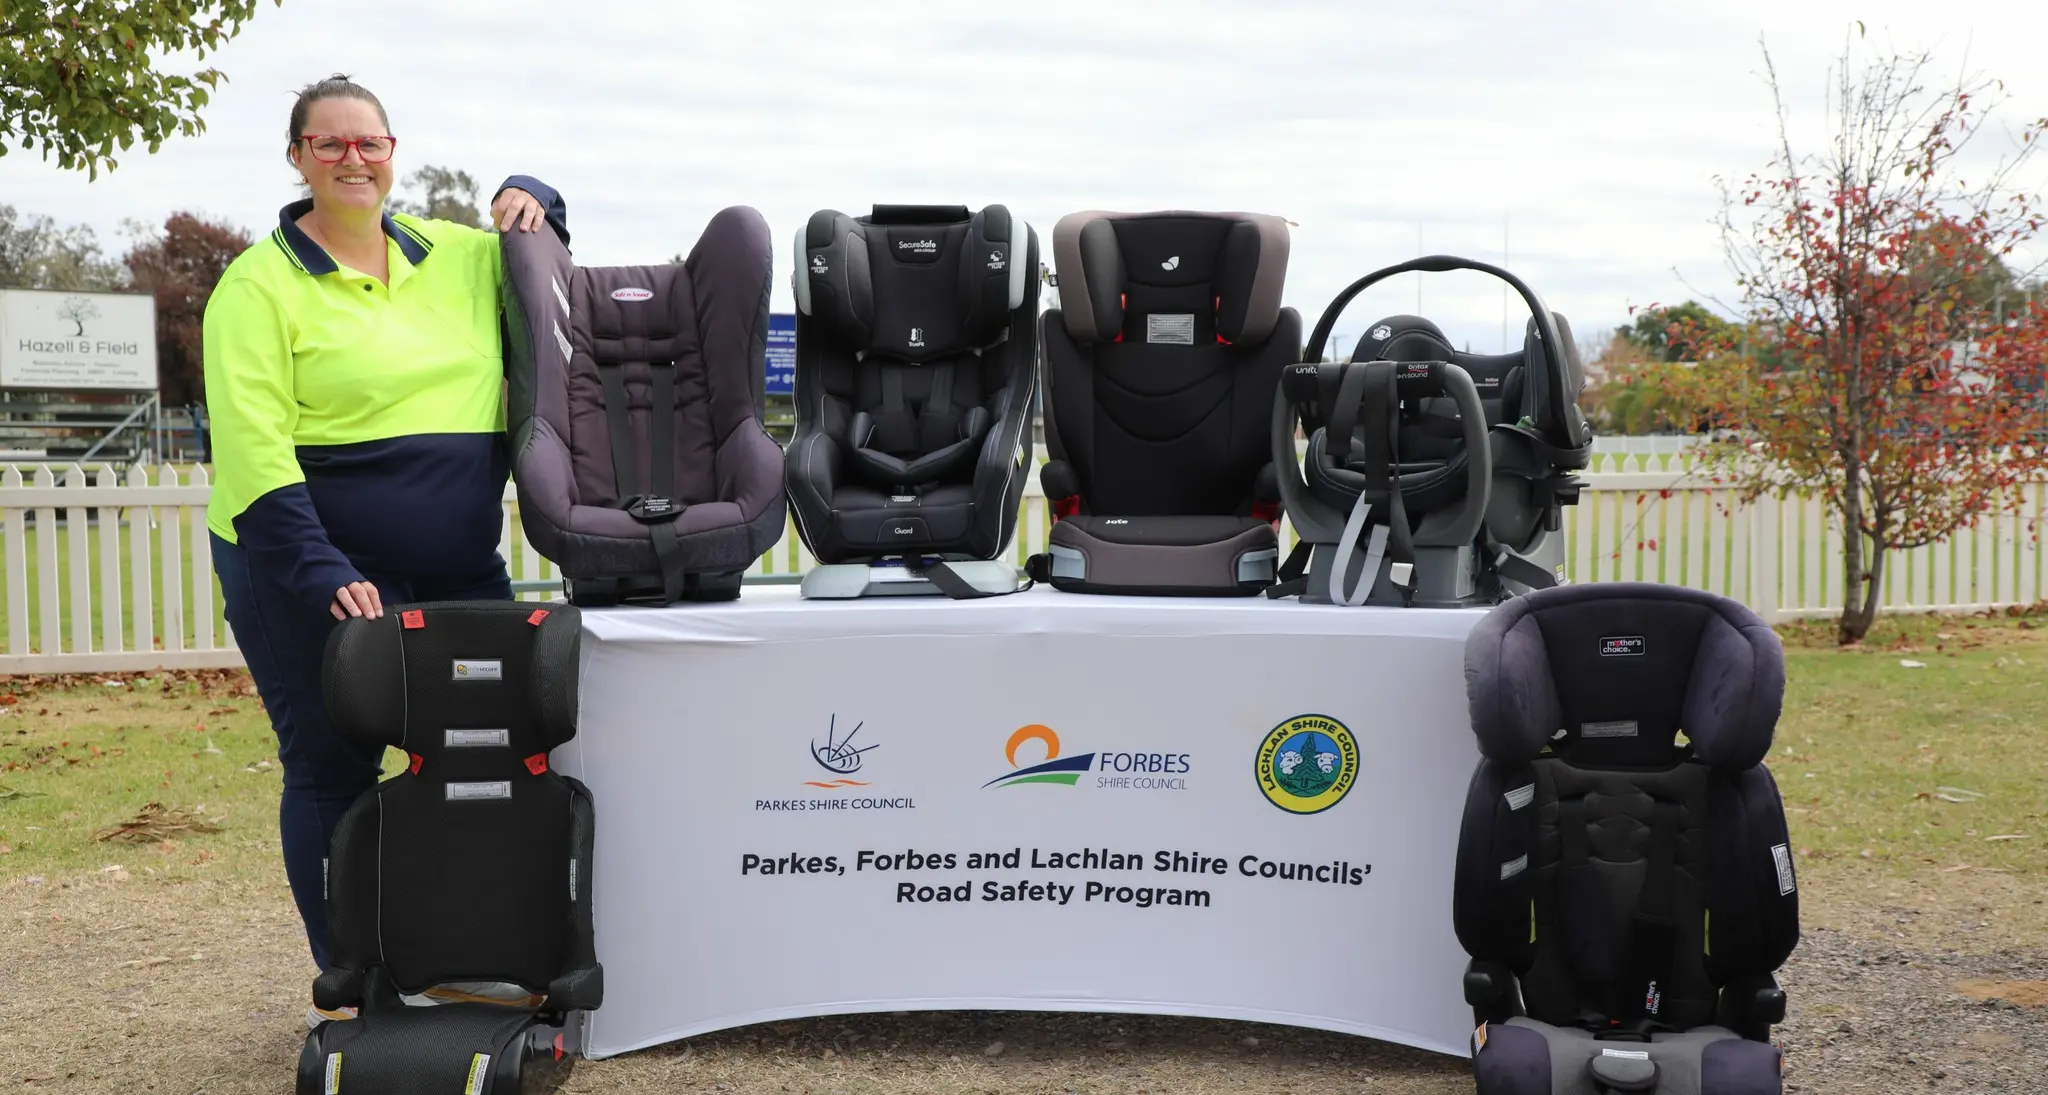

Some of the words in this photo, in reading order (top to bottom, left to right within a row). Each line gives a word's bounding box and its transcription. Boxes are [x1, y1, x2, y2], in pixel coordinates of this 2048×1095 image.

[899, 240, 936, 249] SecureSafe
[19, 339, 73, 353] Hazell
[79, 341, 90, 354] &
[96, 341, 138, 355] Field
[894, 526, 913, 535] Guard
[1100, 752, 1190, 773] FORBES
[1261, 728, 1289, 792] LACHLAN
[1291, 719, 1338, 734] SHIRE
[1331, 731, 1354, 793] COUNCIL
[1097, 776, 1131, 789] SHIRE
[1133, 777, 1188, 790] COUNCIL
[755, 800, 806, 811] PARKES
[809, 799, 848, 810] SHIRE
[851, 798, 916, 809] COUNCIL
[741, 852, 845, 876] Parkes,
[856, 849, 957, 871] Forbes
[966, 848, 1021, 869] and
[1031, 848, 1143, 870] Lachlan
[1153, 850, 1228, 874] Shire
[1238, 855, 1372, 885] Councils’
[896, 881, 972, 903] Road
[981, 880, 1074, 905] Safety
[1085, 881, 1211, 908] Program
